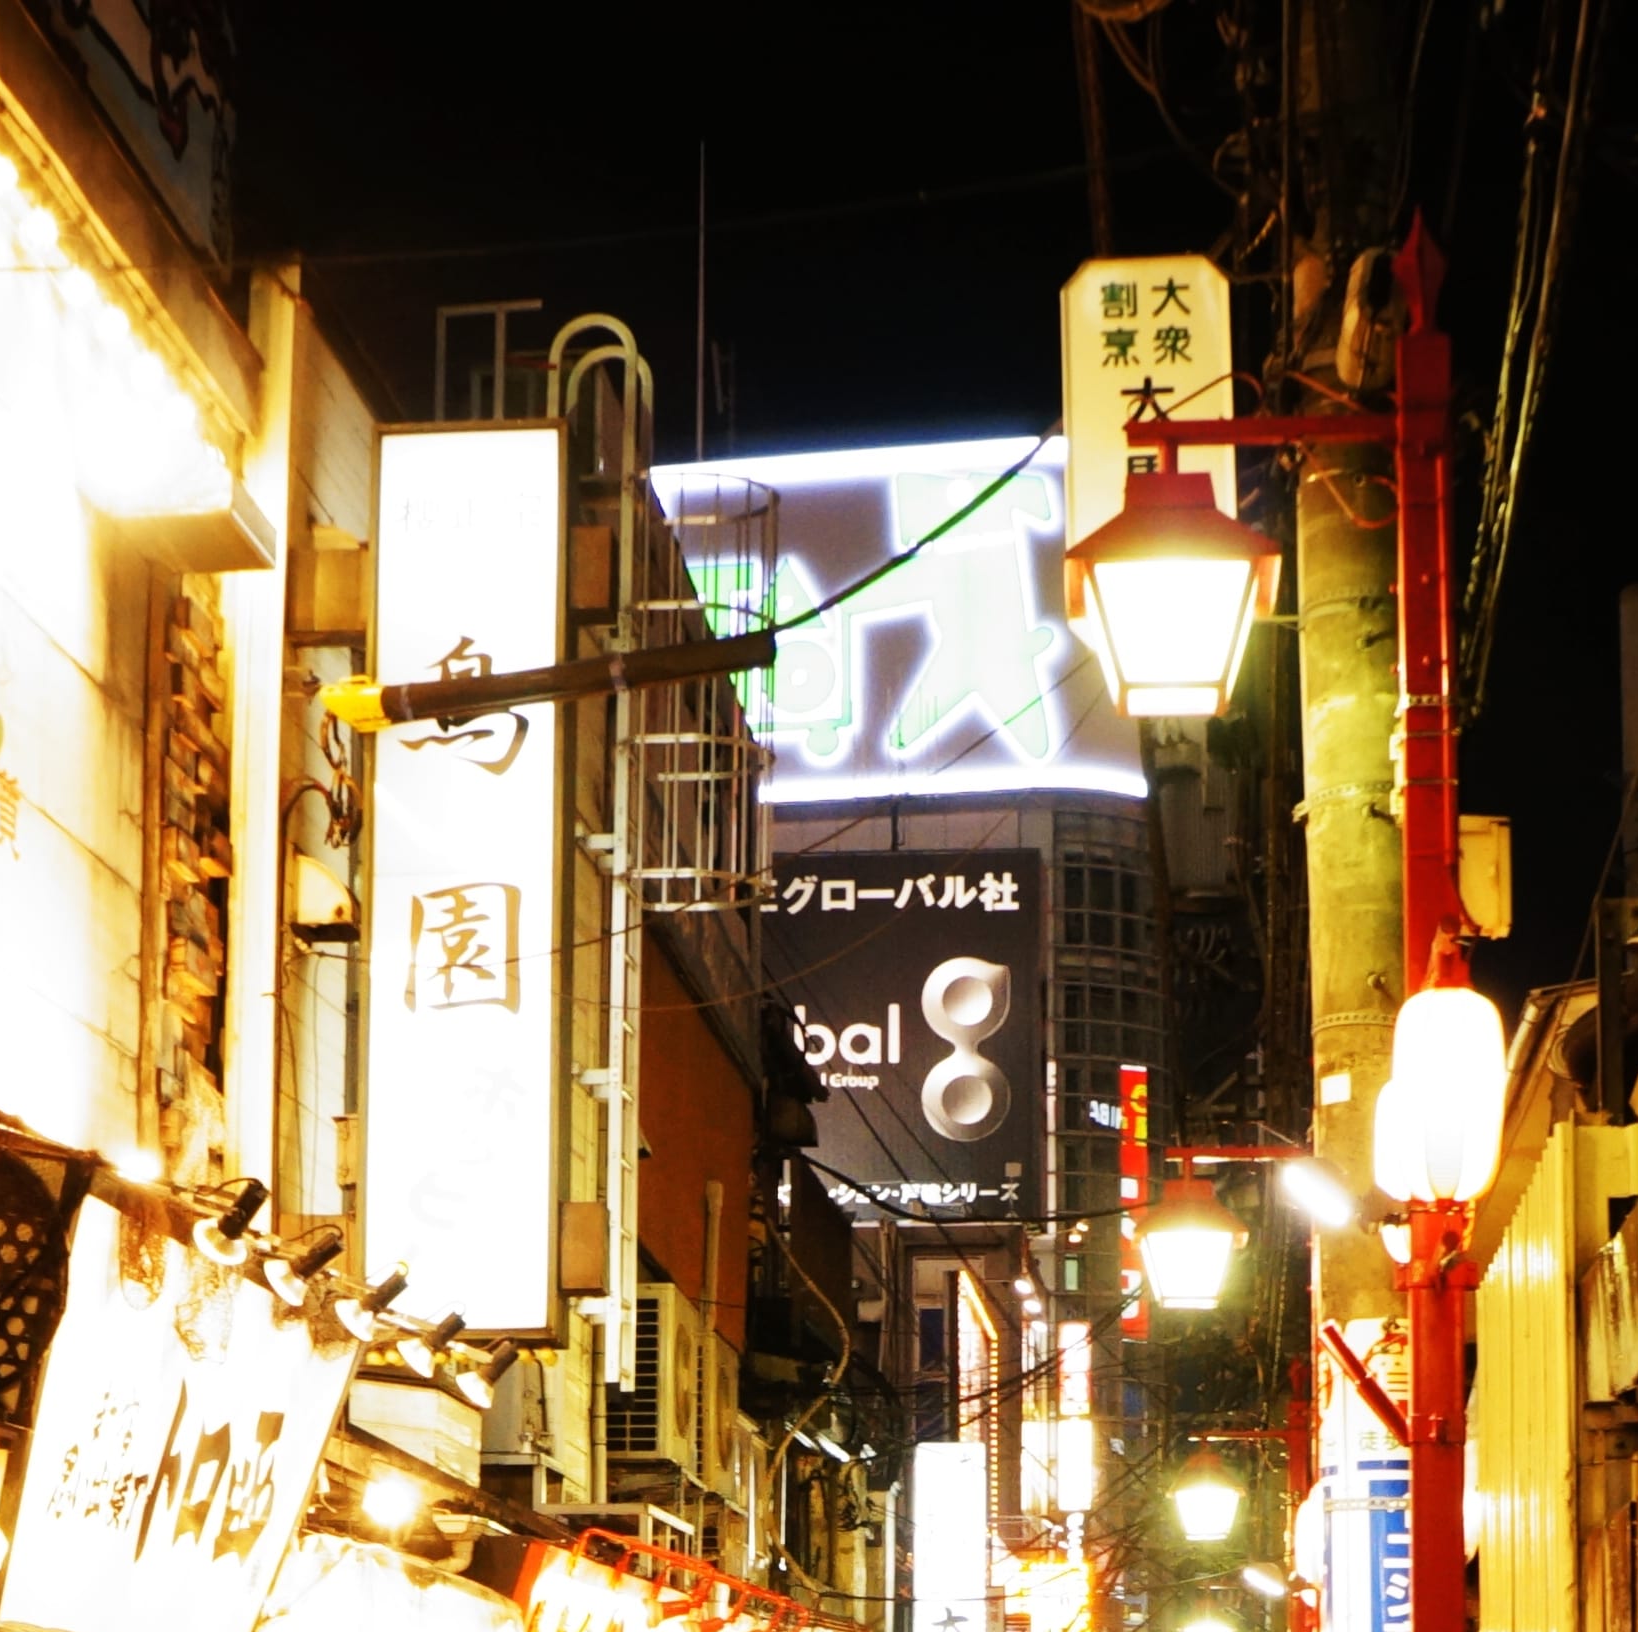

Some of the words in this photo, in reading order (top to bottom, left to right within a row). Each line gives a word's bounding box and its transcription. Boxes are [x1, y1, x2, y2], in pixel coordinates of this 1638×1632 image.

[1100, 281, 1140, 367] 割烹
[1151, 276, 1193, 365] 大衆
[793, 1003, 901, 1065] bal
